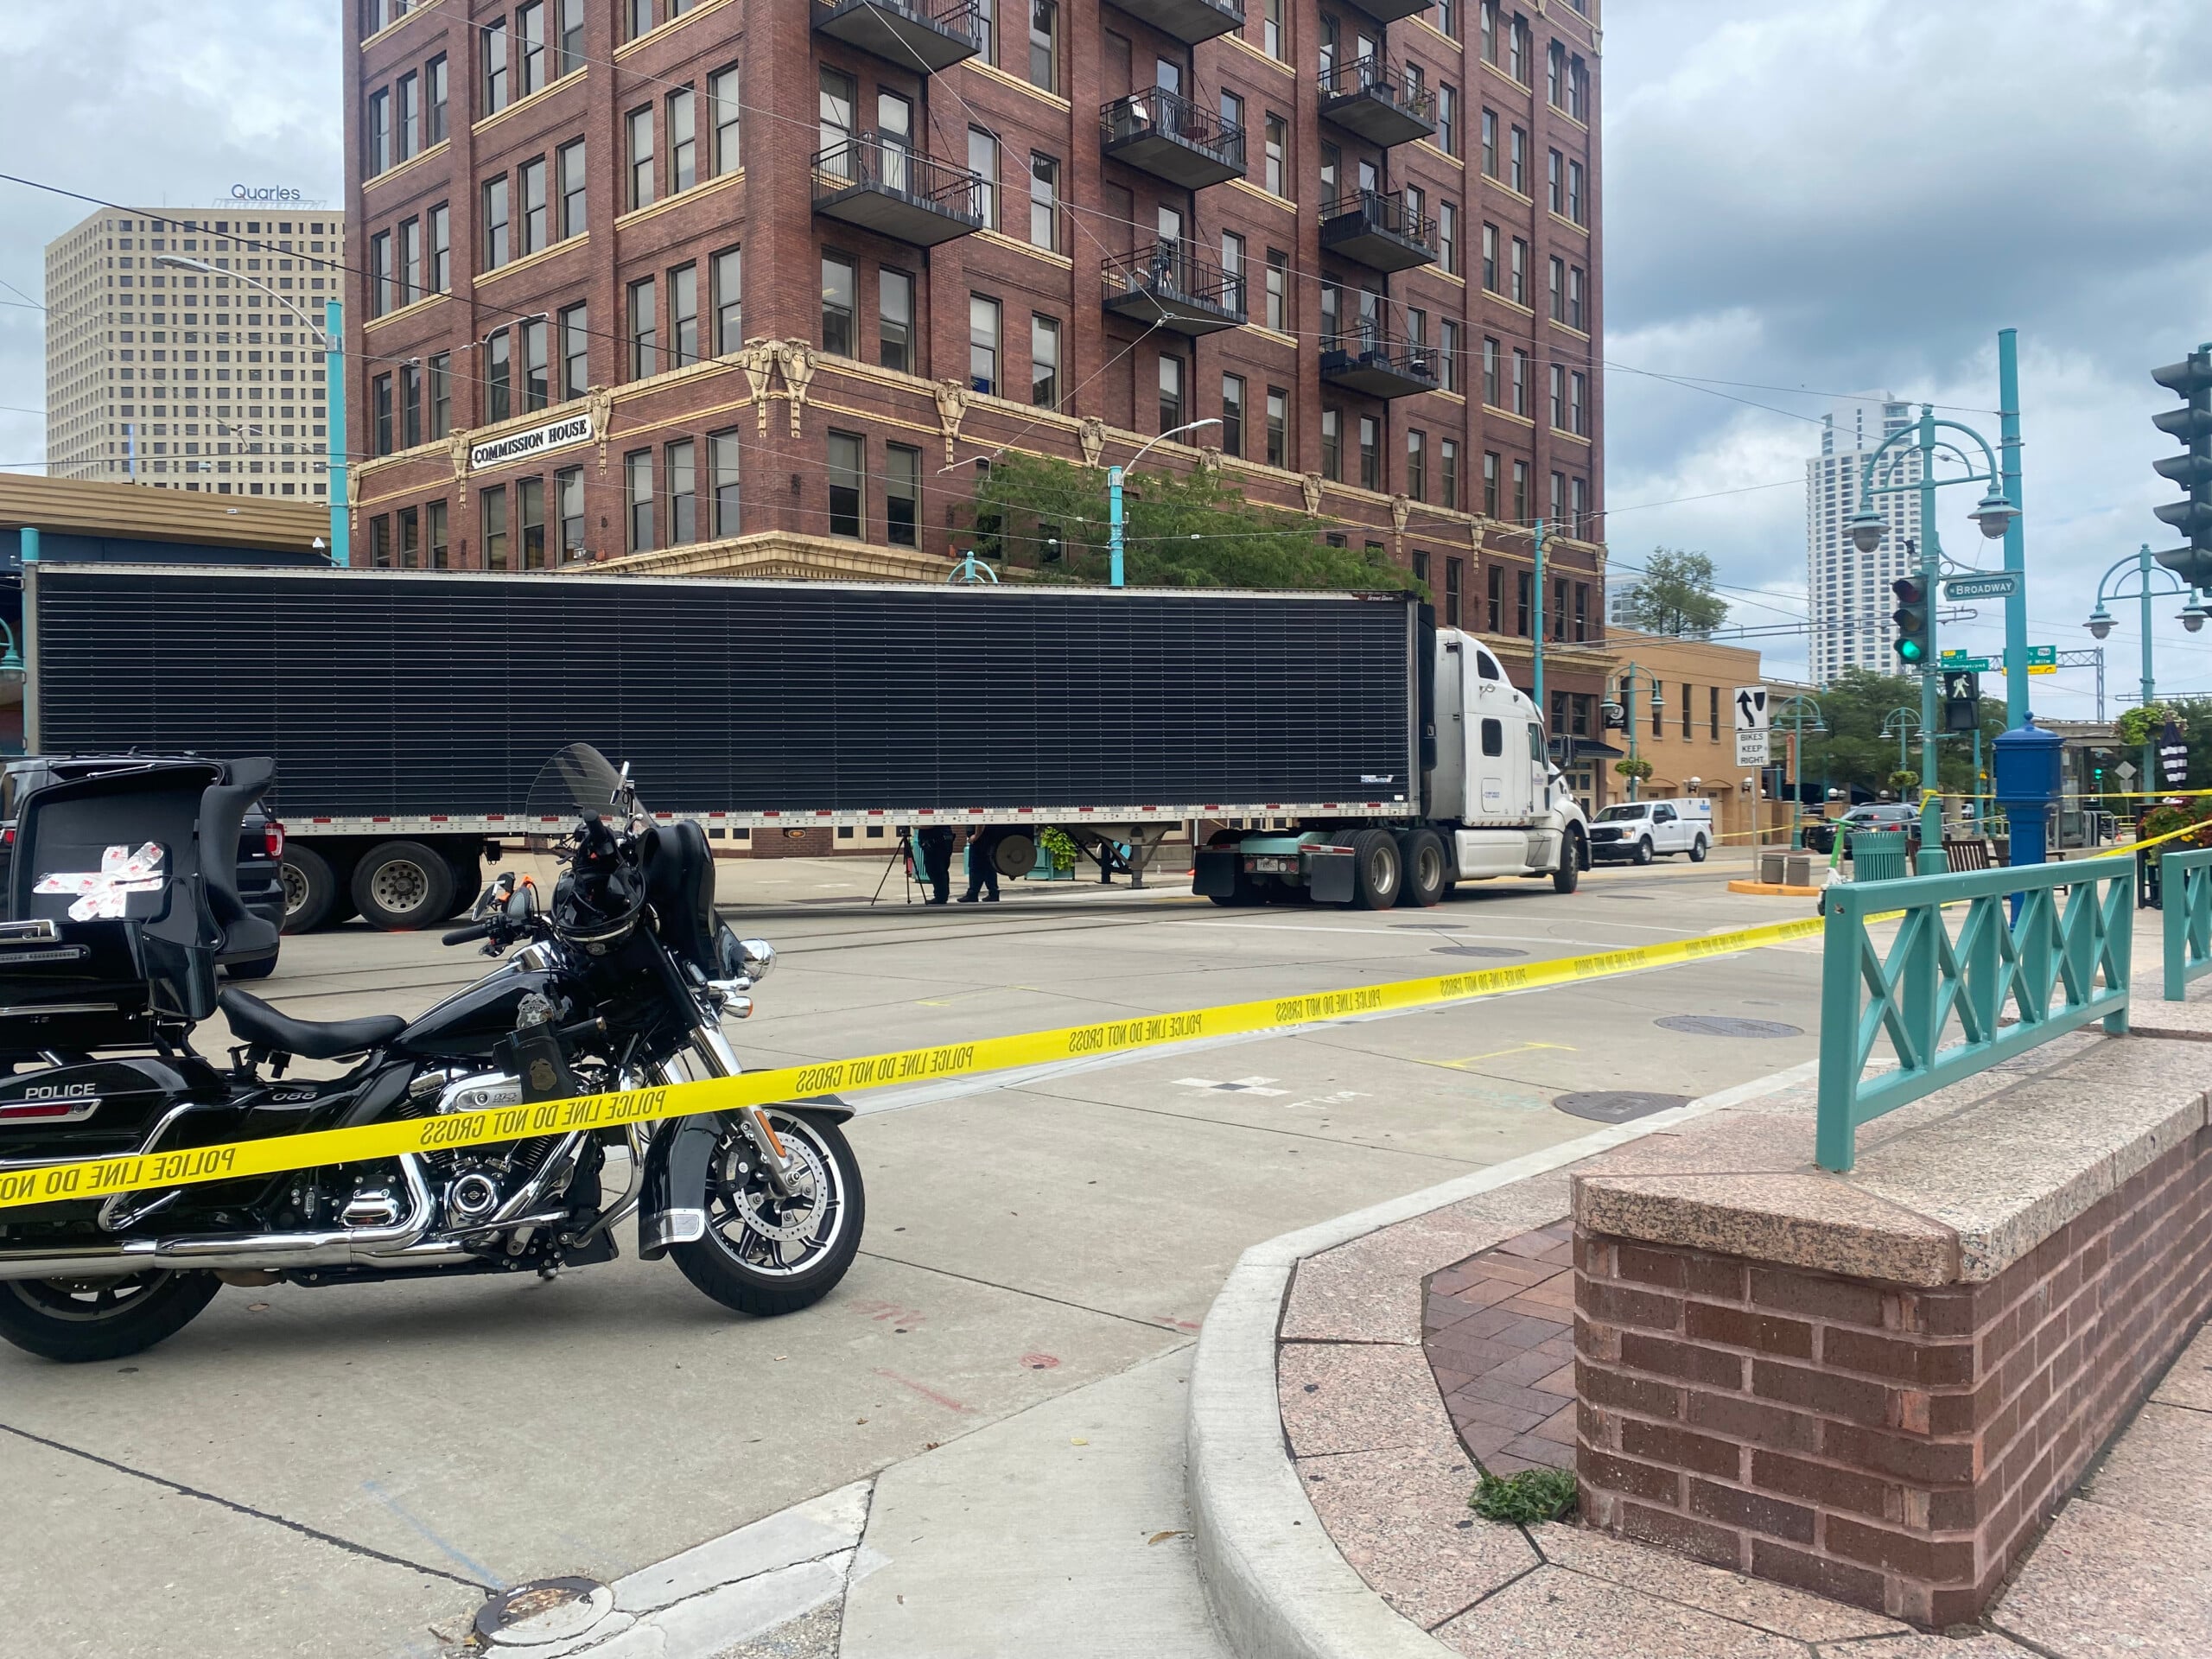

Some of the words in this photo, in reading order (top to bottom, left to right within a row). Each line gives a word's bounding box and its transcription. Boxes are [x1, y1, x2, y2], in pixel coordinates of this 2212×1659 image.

[232, 183, 300, 200] Quarles
[475, 432, 543, 463] COMMISSION
[549, 419, 587, 443] HOUSE
[1956, 582, 2012, 594] BROADWAY
[25, 1084, 96, 1099] POLICE
[272, 1091, 317, 1101] 088
